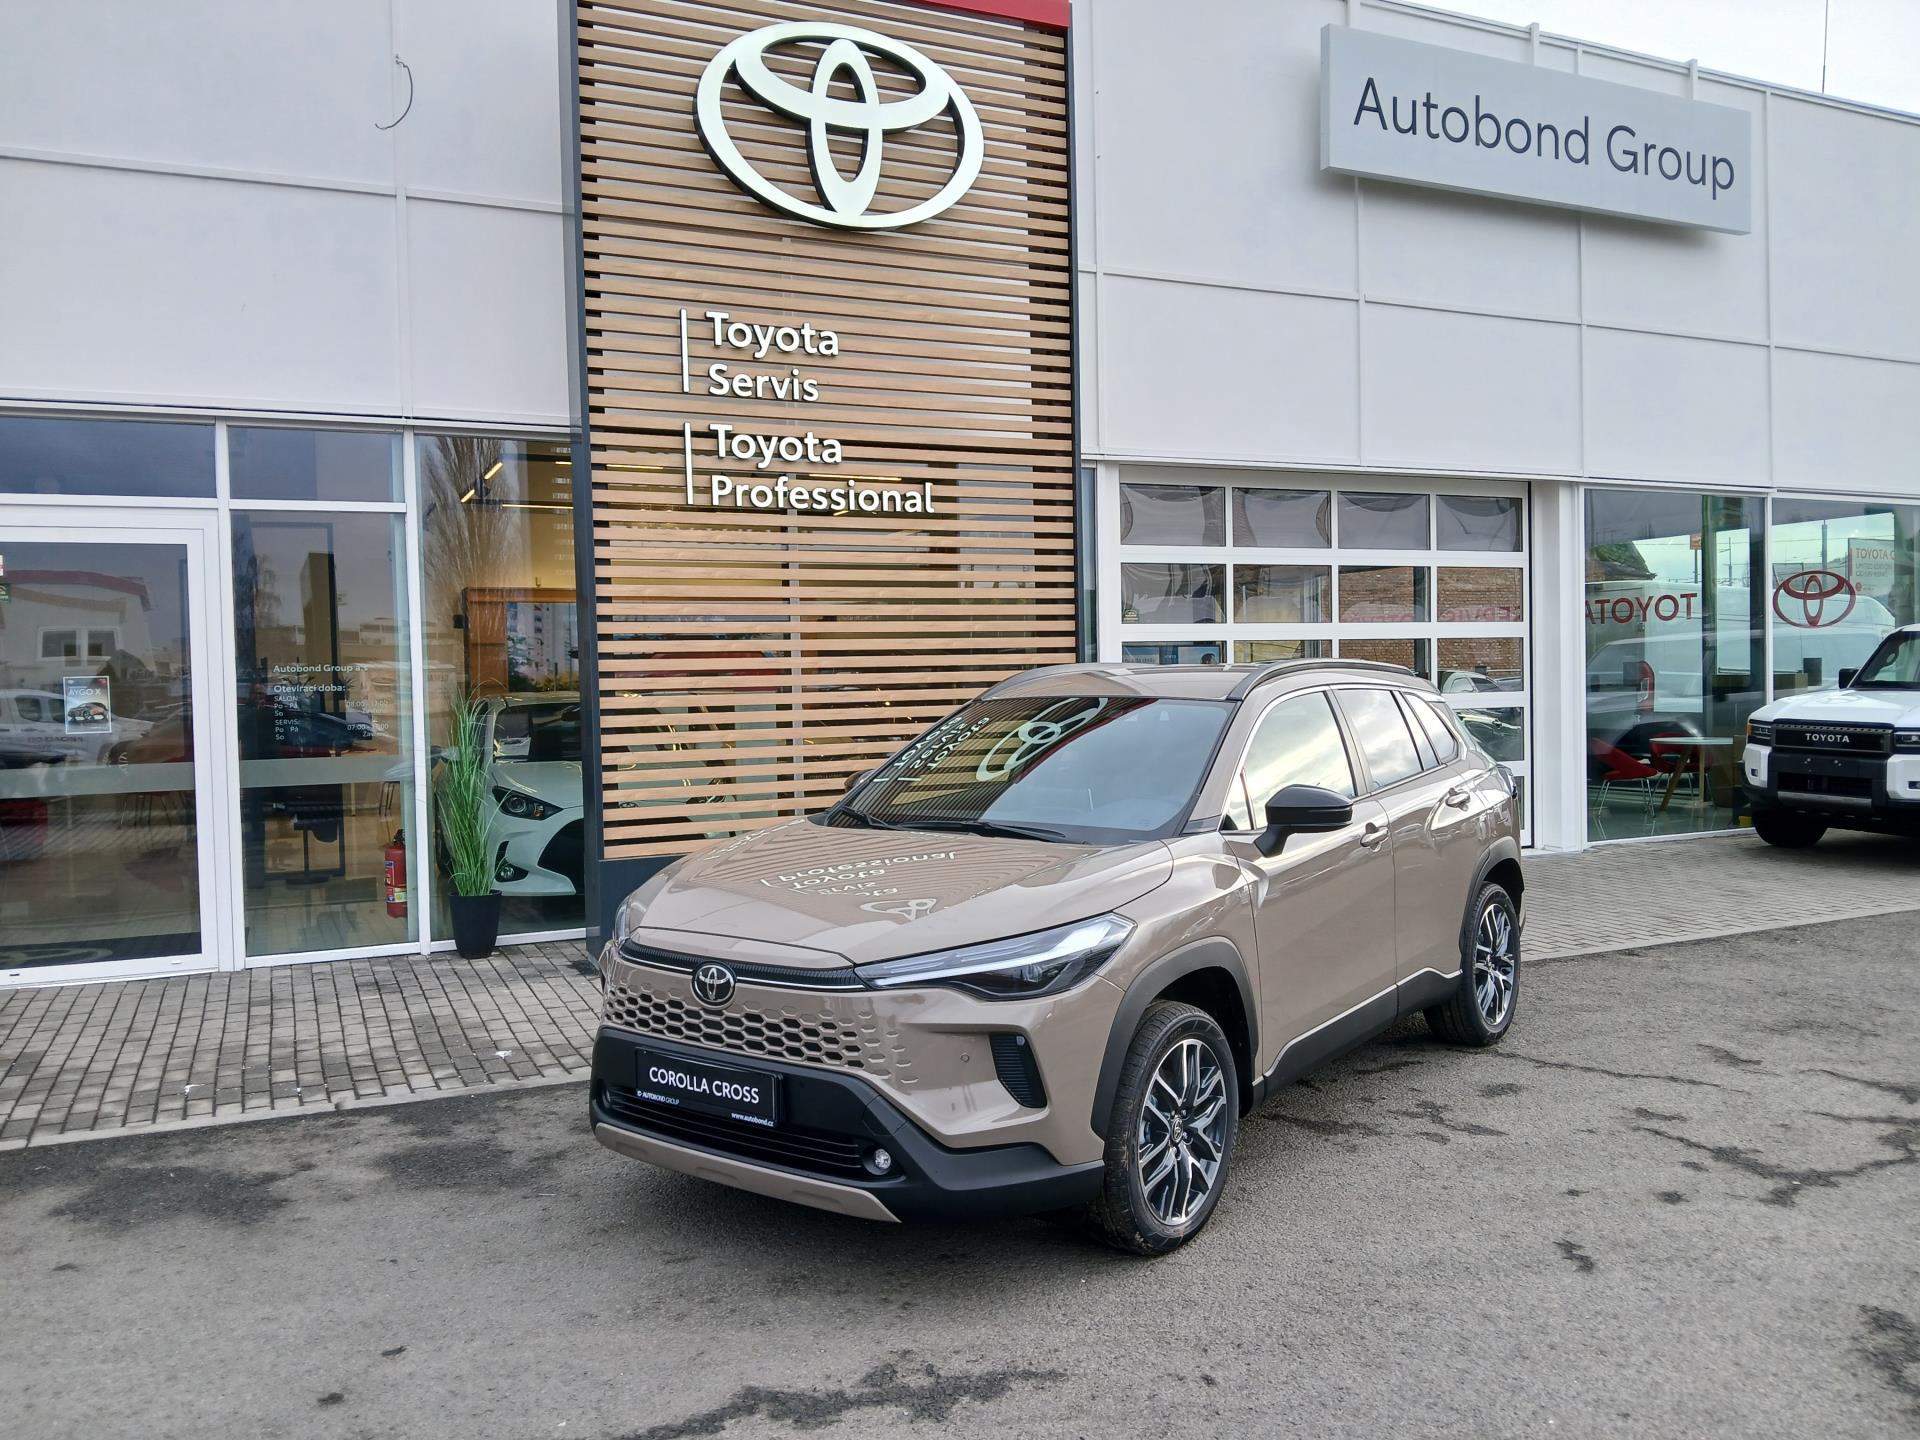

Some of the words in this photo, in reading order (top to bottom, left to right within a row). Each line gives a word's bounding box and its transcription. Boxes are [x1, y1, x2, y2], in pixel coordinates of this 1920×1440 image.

[1353, 77, 1590, 166] Autobond
[1606, 124, 1735, 200] Group
[705, 310, 840, 359] Toyota
[708, 363, 820, 402] Servis
[709, 423, 843, 469] Toyota
[711, 474, 935, 513] Professional
[273, 664, 321, 673] Autobond
[323, 664, 354, 673] Group
[273, 684, 317, 693] Otevírací
[318, 683, 346, 692] doba:
[1805, 733, 1850, 743] TOYOTA
[649, 1066, 710, 1094] COROLLA
[712, 1080, 760, 1104] CROSS
